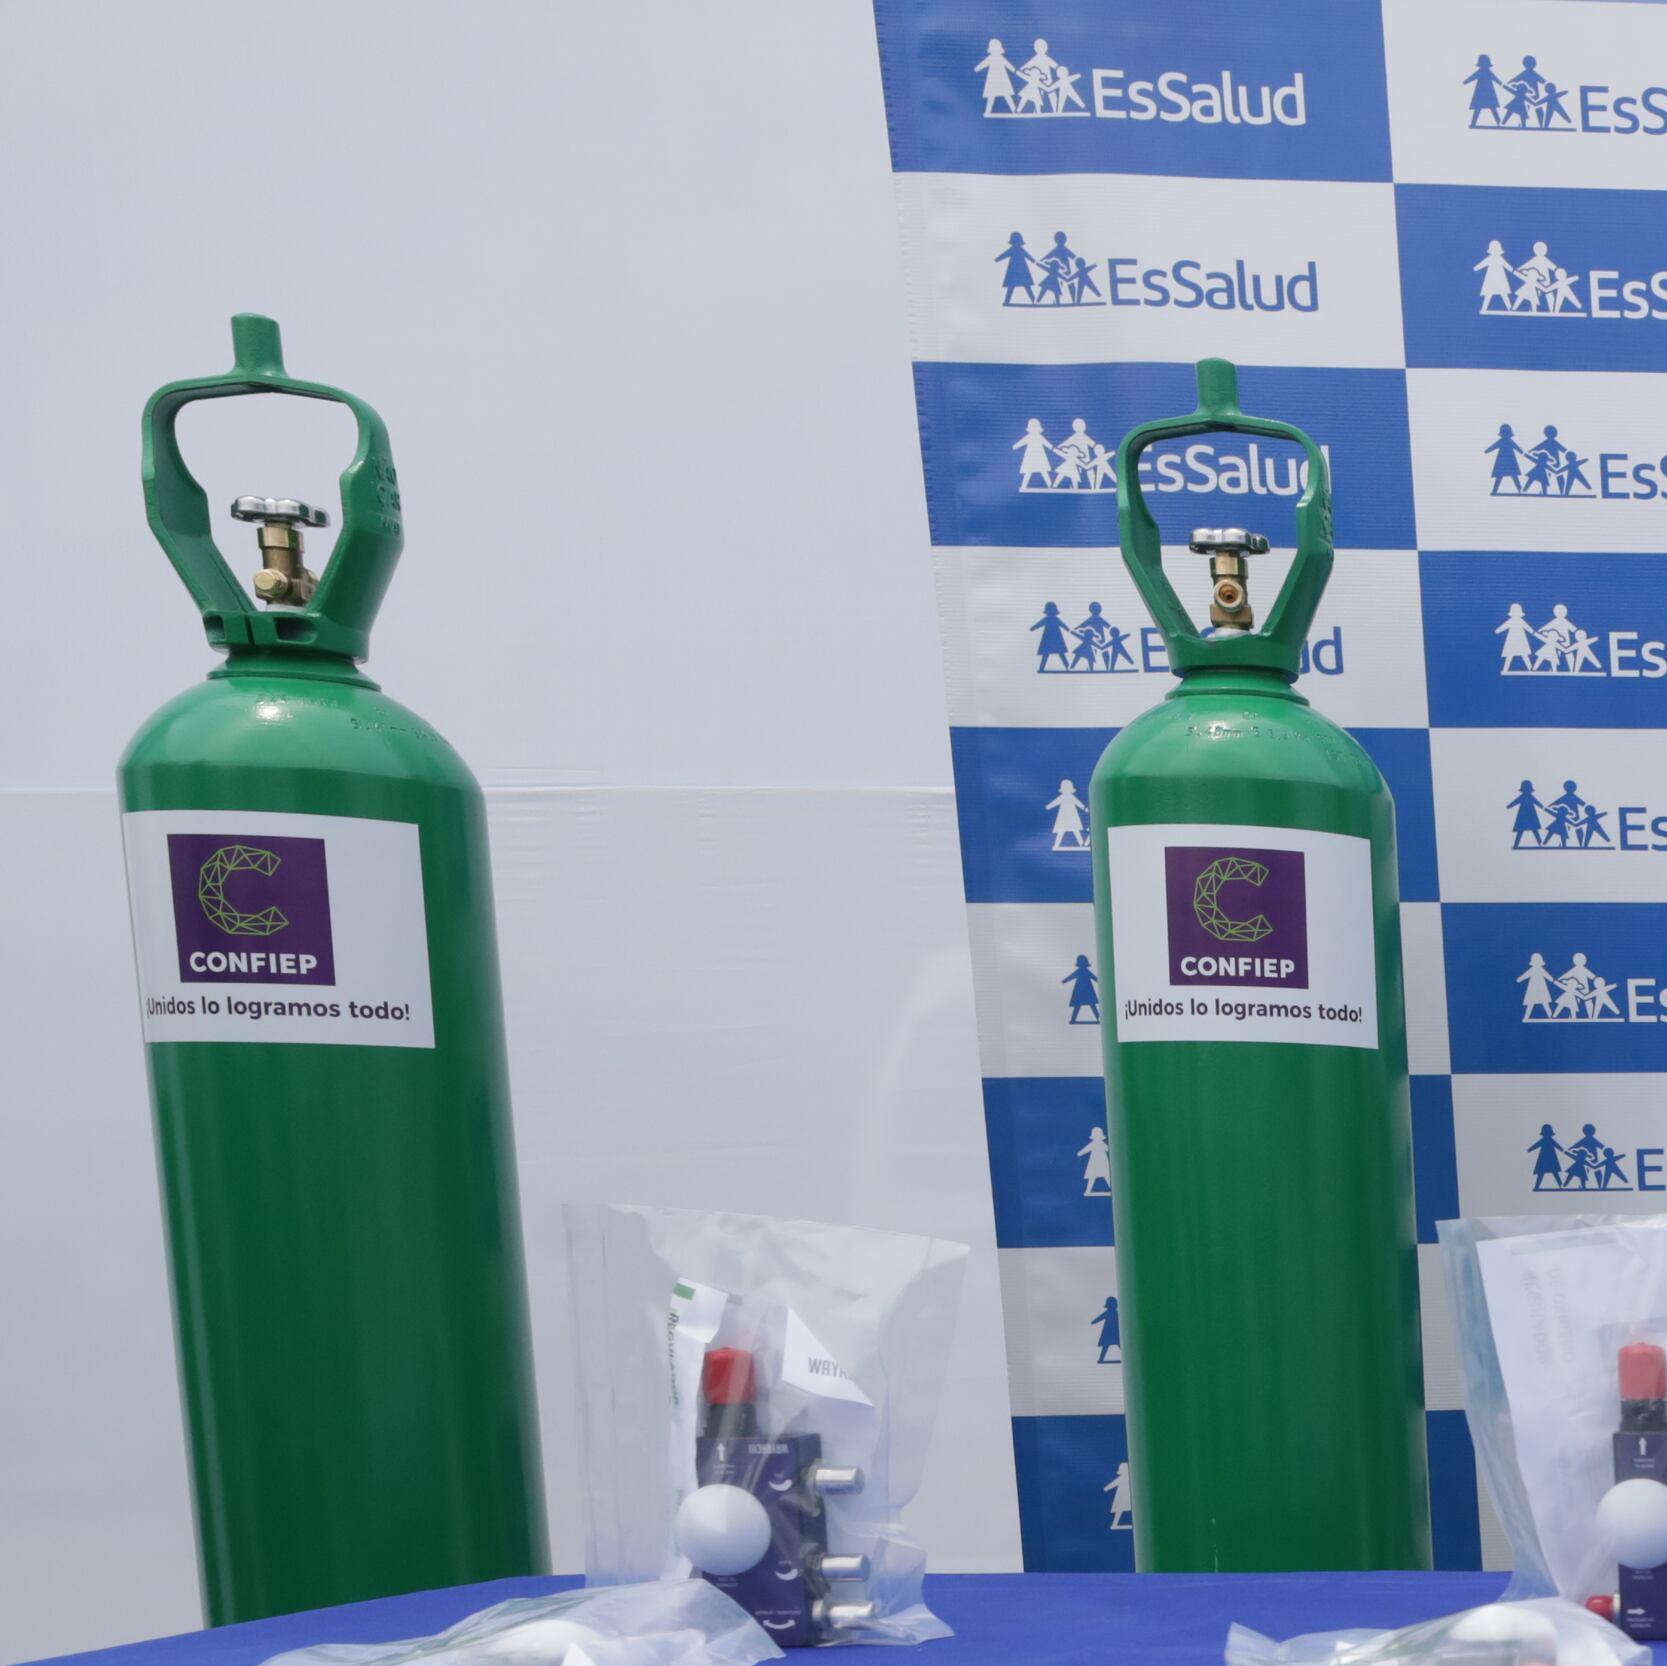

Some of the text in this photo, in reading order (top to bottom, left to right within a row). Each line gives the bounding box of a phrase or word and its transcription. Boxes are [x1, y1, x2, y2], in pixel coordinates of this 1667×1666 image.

[1093, 69, 1306, 125] EsSalud
[1108, 259, 1318, 312] EsSalud
[189, 951, 318, 975] CONFIEP
[1180, 956, 1296, 979] CONFIEP
[202, 996, 220, 1015] lo
[228, 997, 341, 1020] logramos
[348, 1001, 410, 1021] todo!
[1124, 998, 1363, 1023] ¡Unidos lo logramos todo!
